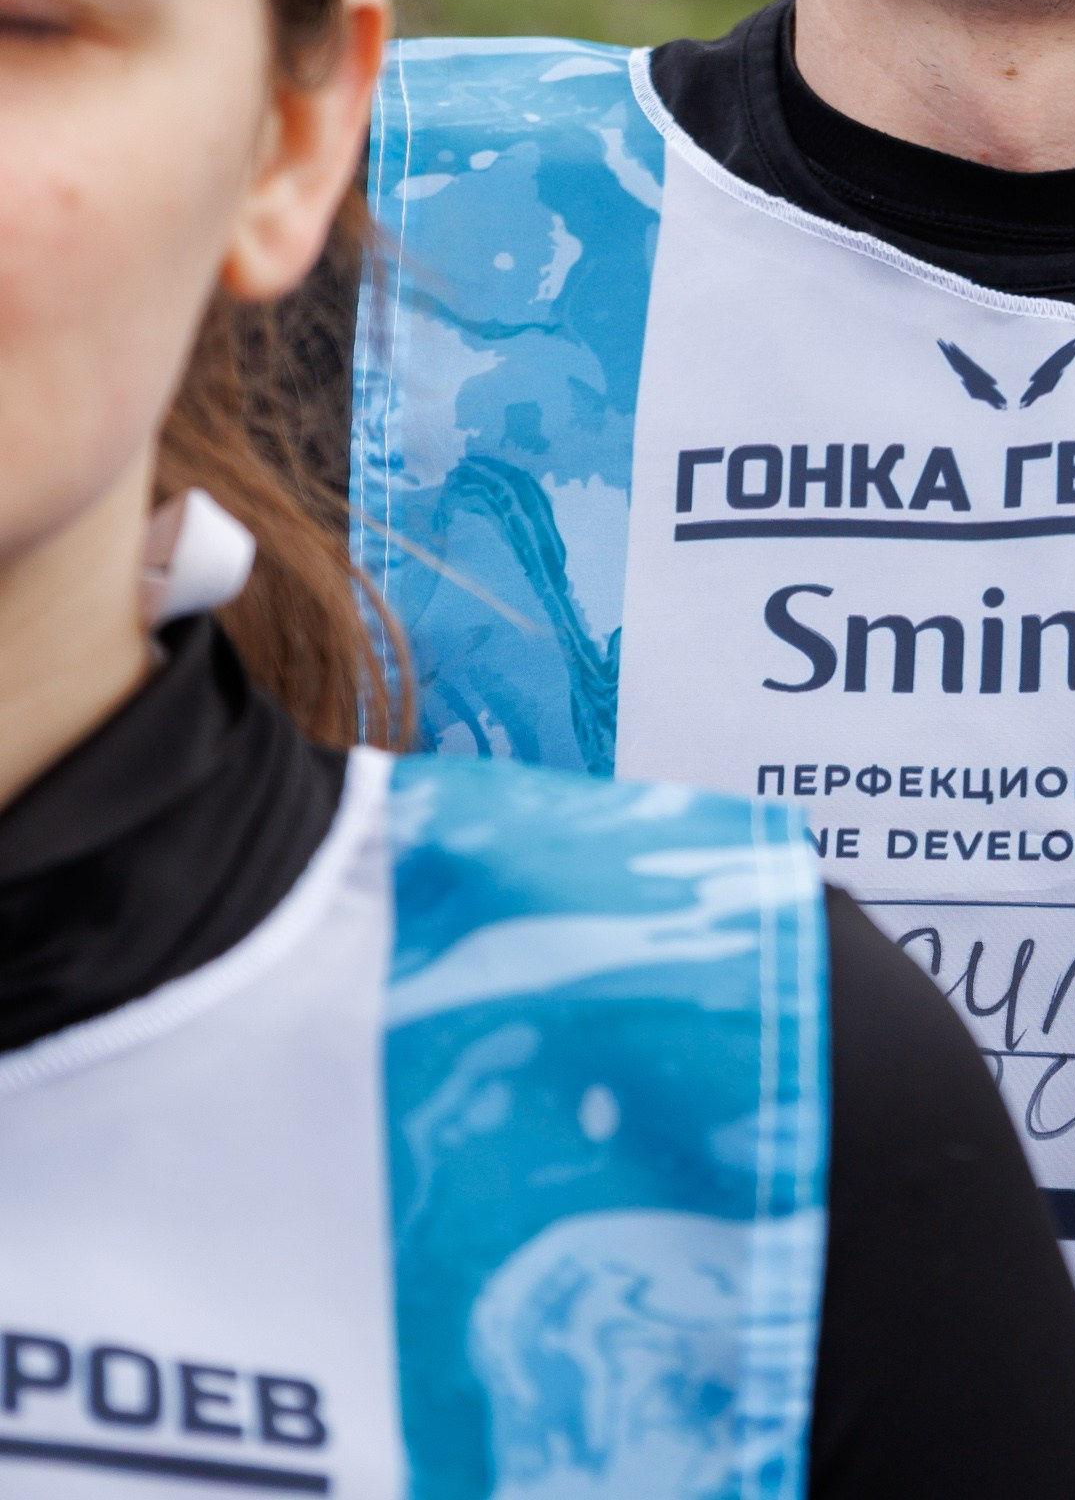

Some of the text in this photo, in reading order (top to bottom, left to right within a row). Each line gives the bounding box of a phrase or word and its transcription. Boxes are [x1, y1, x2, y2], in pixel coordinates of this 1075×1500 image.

[675, 443, 971, 513] ГОНКА
[803, 826, 861, 859] NE
[2, 1332, 327, 1448] РОЕВ
